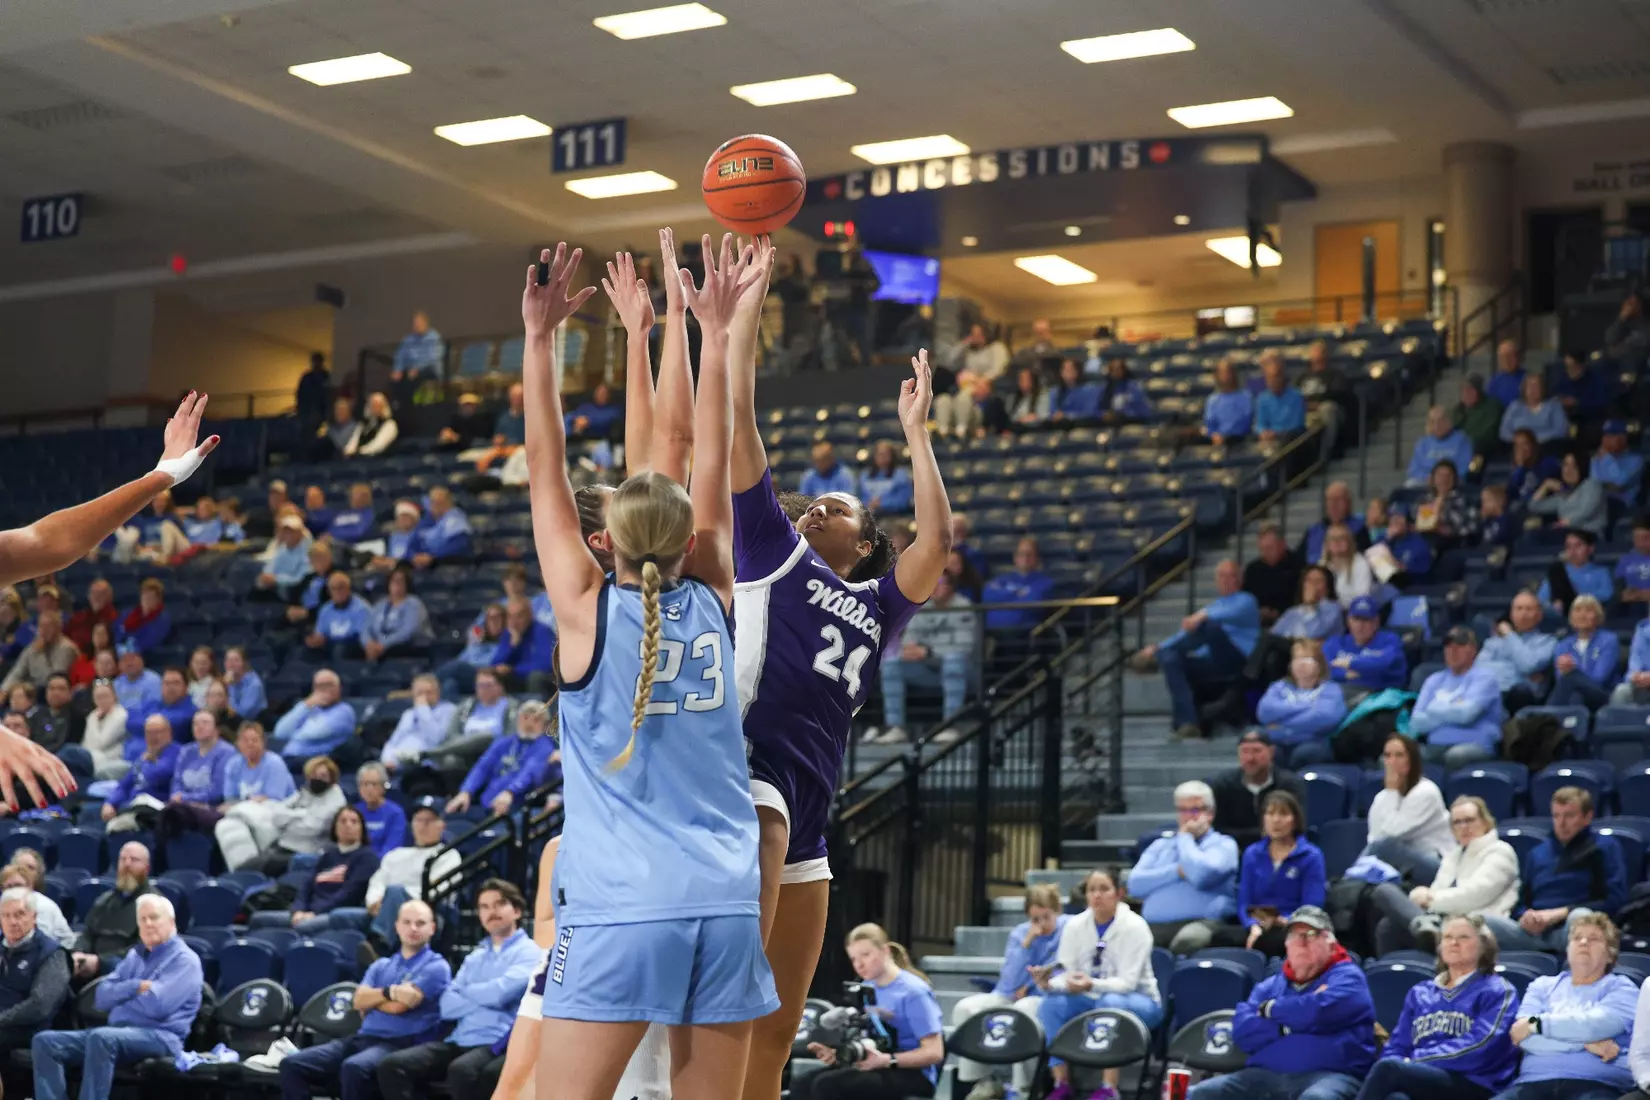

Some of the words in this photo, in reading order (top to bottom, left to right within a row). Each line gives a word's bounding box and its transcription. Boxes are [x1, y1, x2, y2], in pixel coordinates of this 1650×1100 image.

[559, 124, 616, 169] 111
[718, 157, 774, 177] ELITE
[845, 141, 1141, 200] CONCESSIONS
[27, 198, 77, 238] 110
[633, 631, 725, 715] 23
[812, 623, 872, 699] 24
